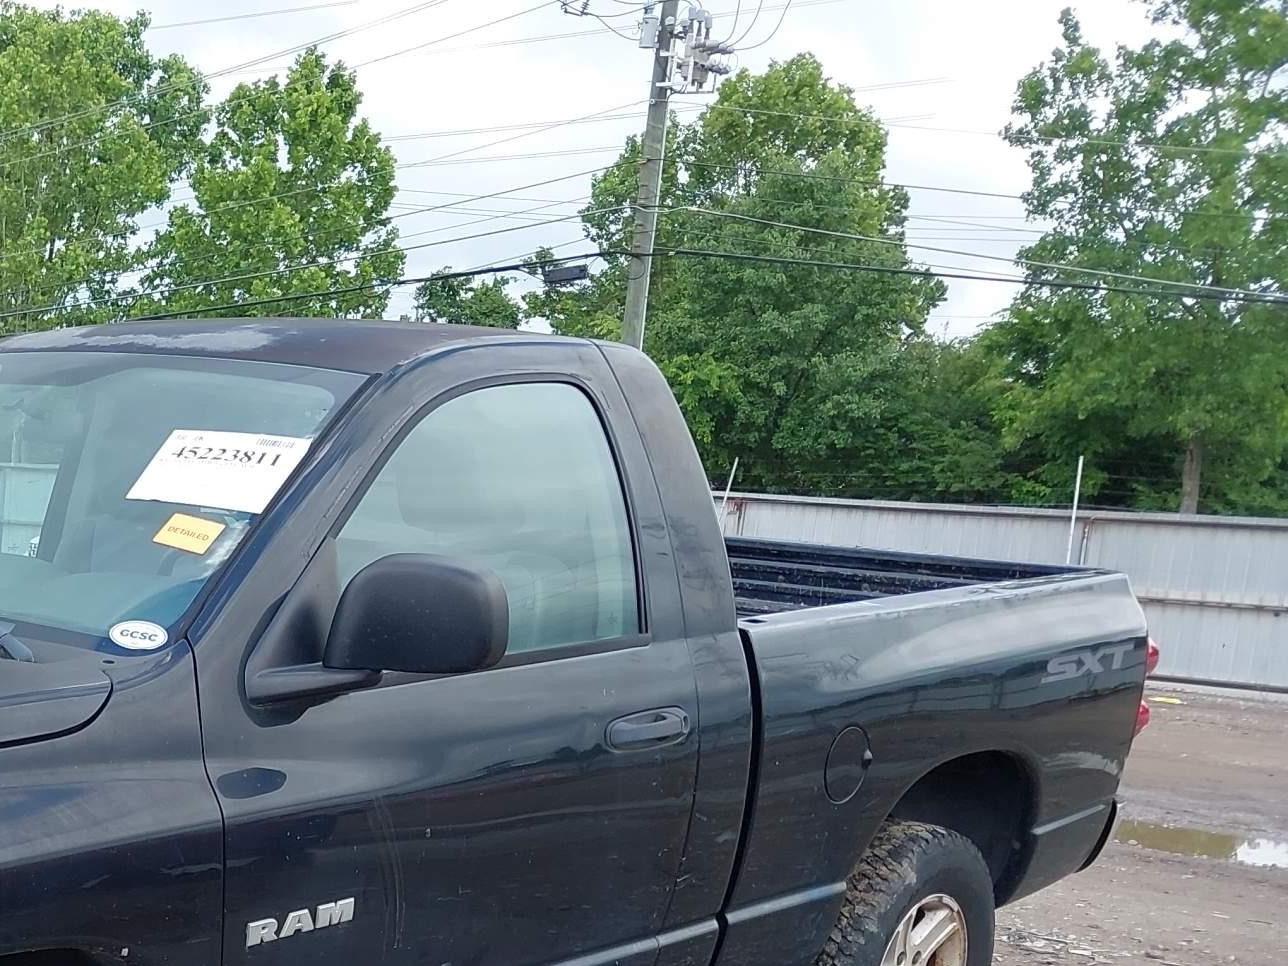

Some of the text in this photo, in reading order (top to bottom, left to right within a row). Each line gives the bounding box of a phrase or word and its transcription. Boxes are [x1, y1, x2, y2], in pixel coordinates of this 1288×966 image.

[172, 446, 283, 467] 45223811
[167, 526, 210, 542] DETAILED
[119, 628, 159, 642] GCSC
[1040, 640, 1136, 684] SXT
[245, 896, 356, 948] RAM
